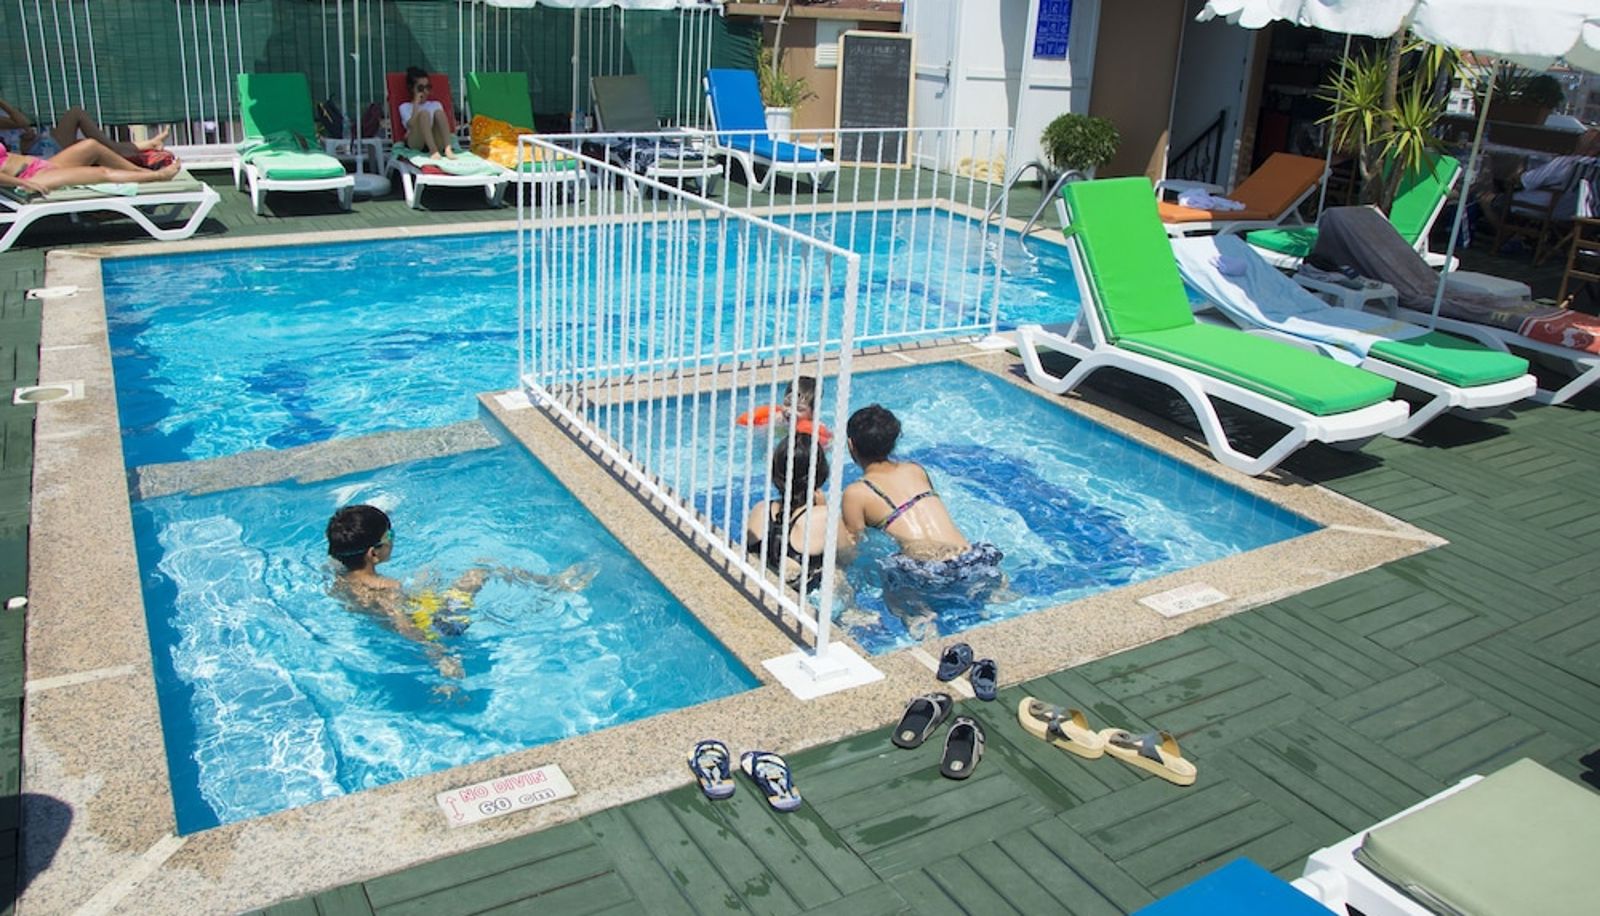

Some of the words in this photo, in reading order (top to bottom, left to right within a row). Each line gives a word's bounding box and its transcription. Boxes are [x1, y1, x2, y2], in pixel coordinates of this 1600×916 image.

[460, 785, 488, 803] NO
[479, 797, 512, 815] 60
[519, 788, 556, 804] cm
